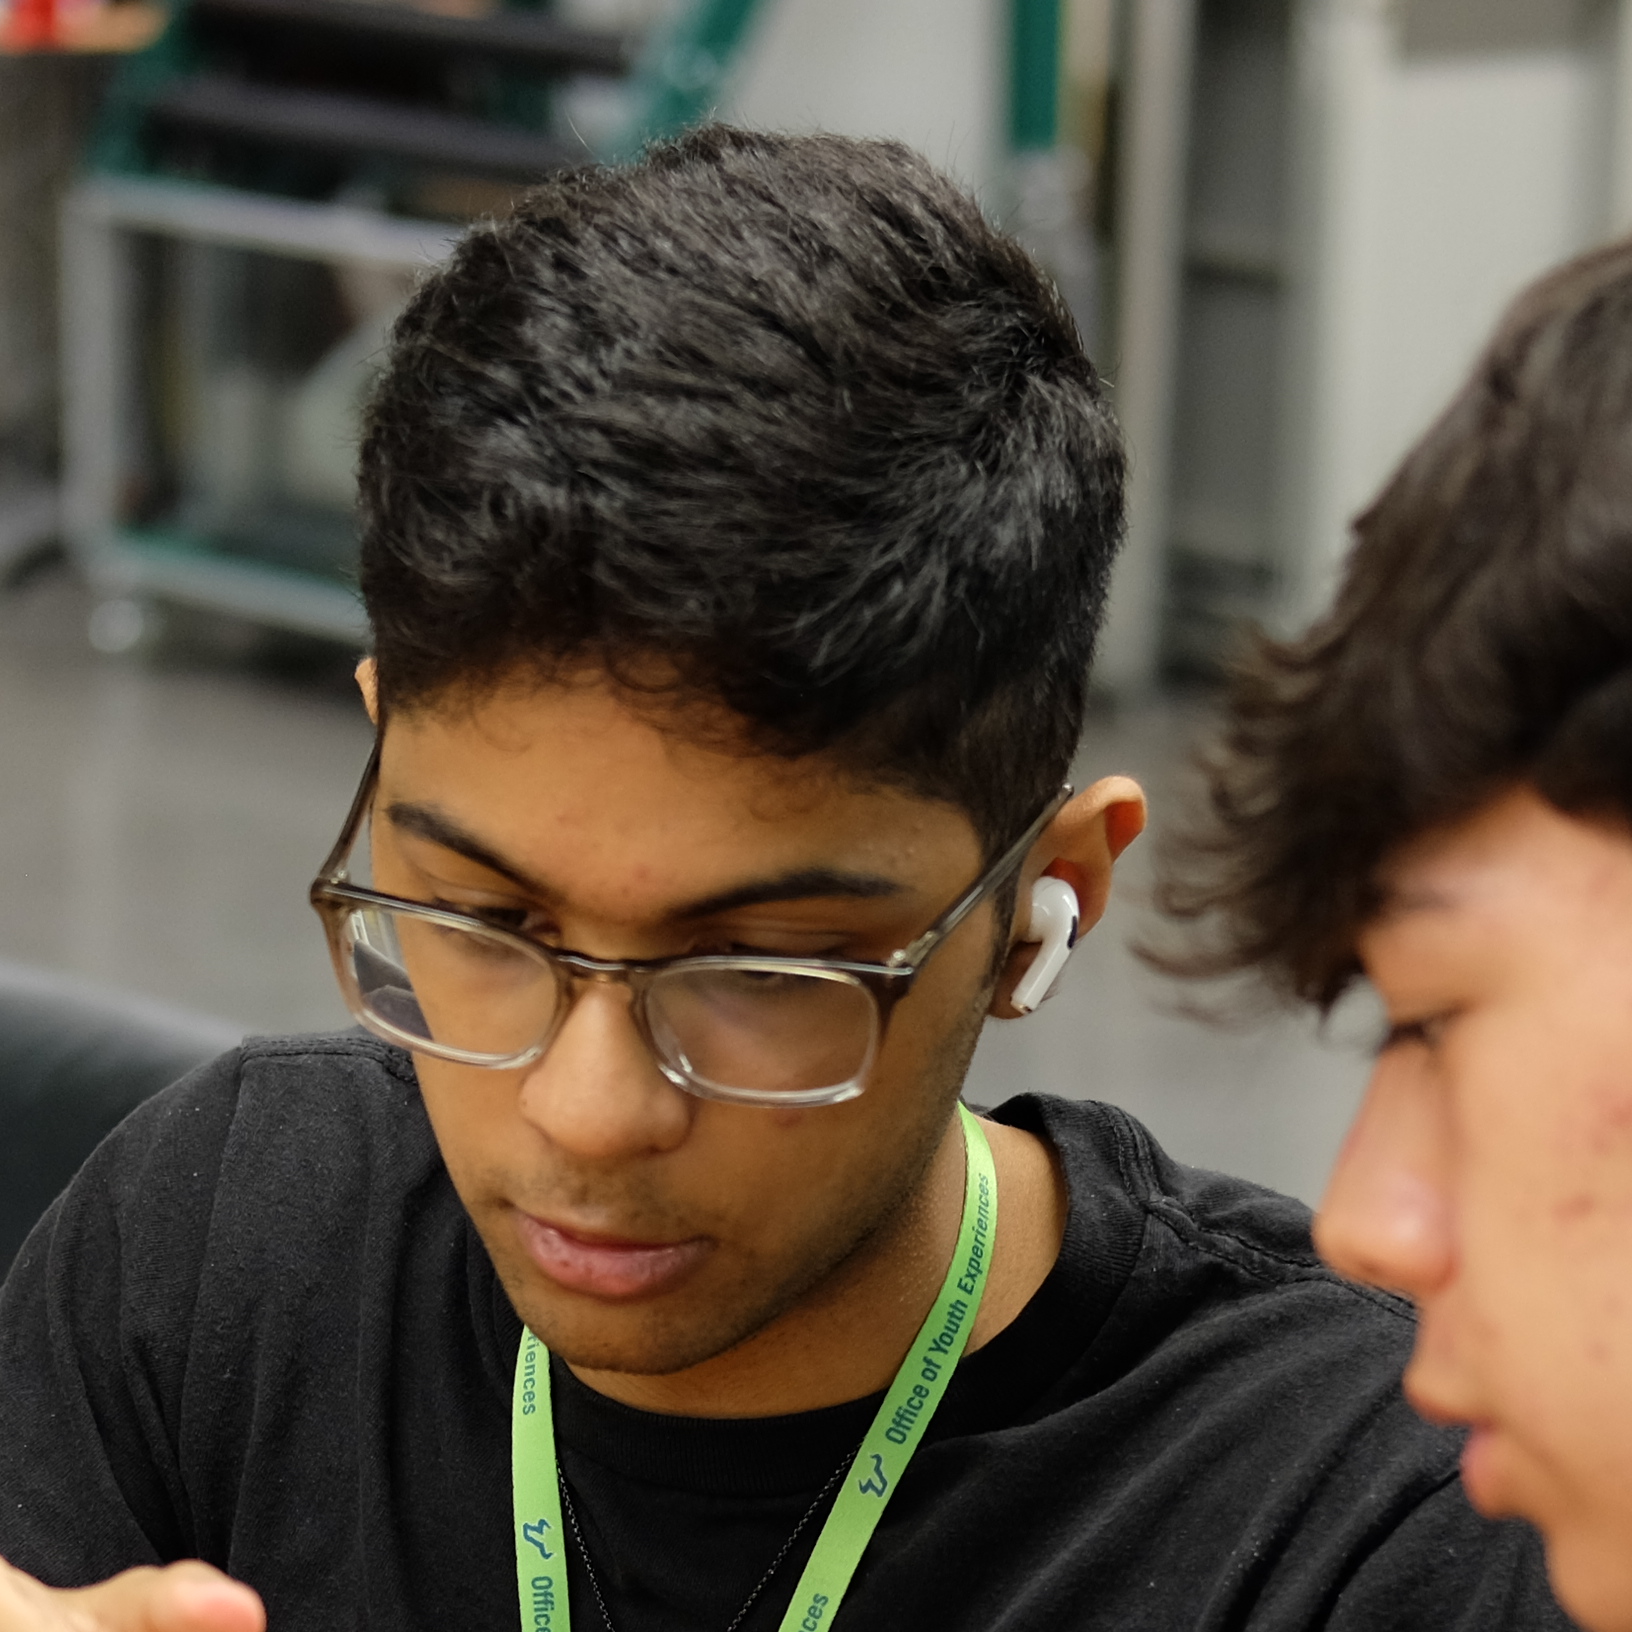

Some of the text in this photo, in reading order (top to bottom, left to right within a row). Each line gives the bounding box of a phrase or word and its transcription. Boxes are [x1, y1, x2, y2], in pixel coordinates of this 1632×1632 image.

[884, 1173, 989, 1445] Office of Youth Experiences
